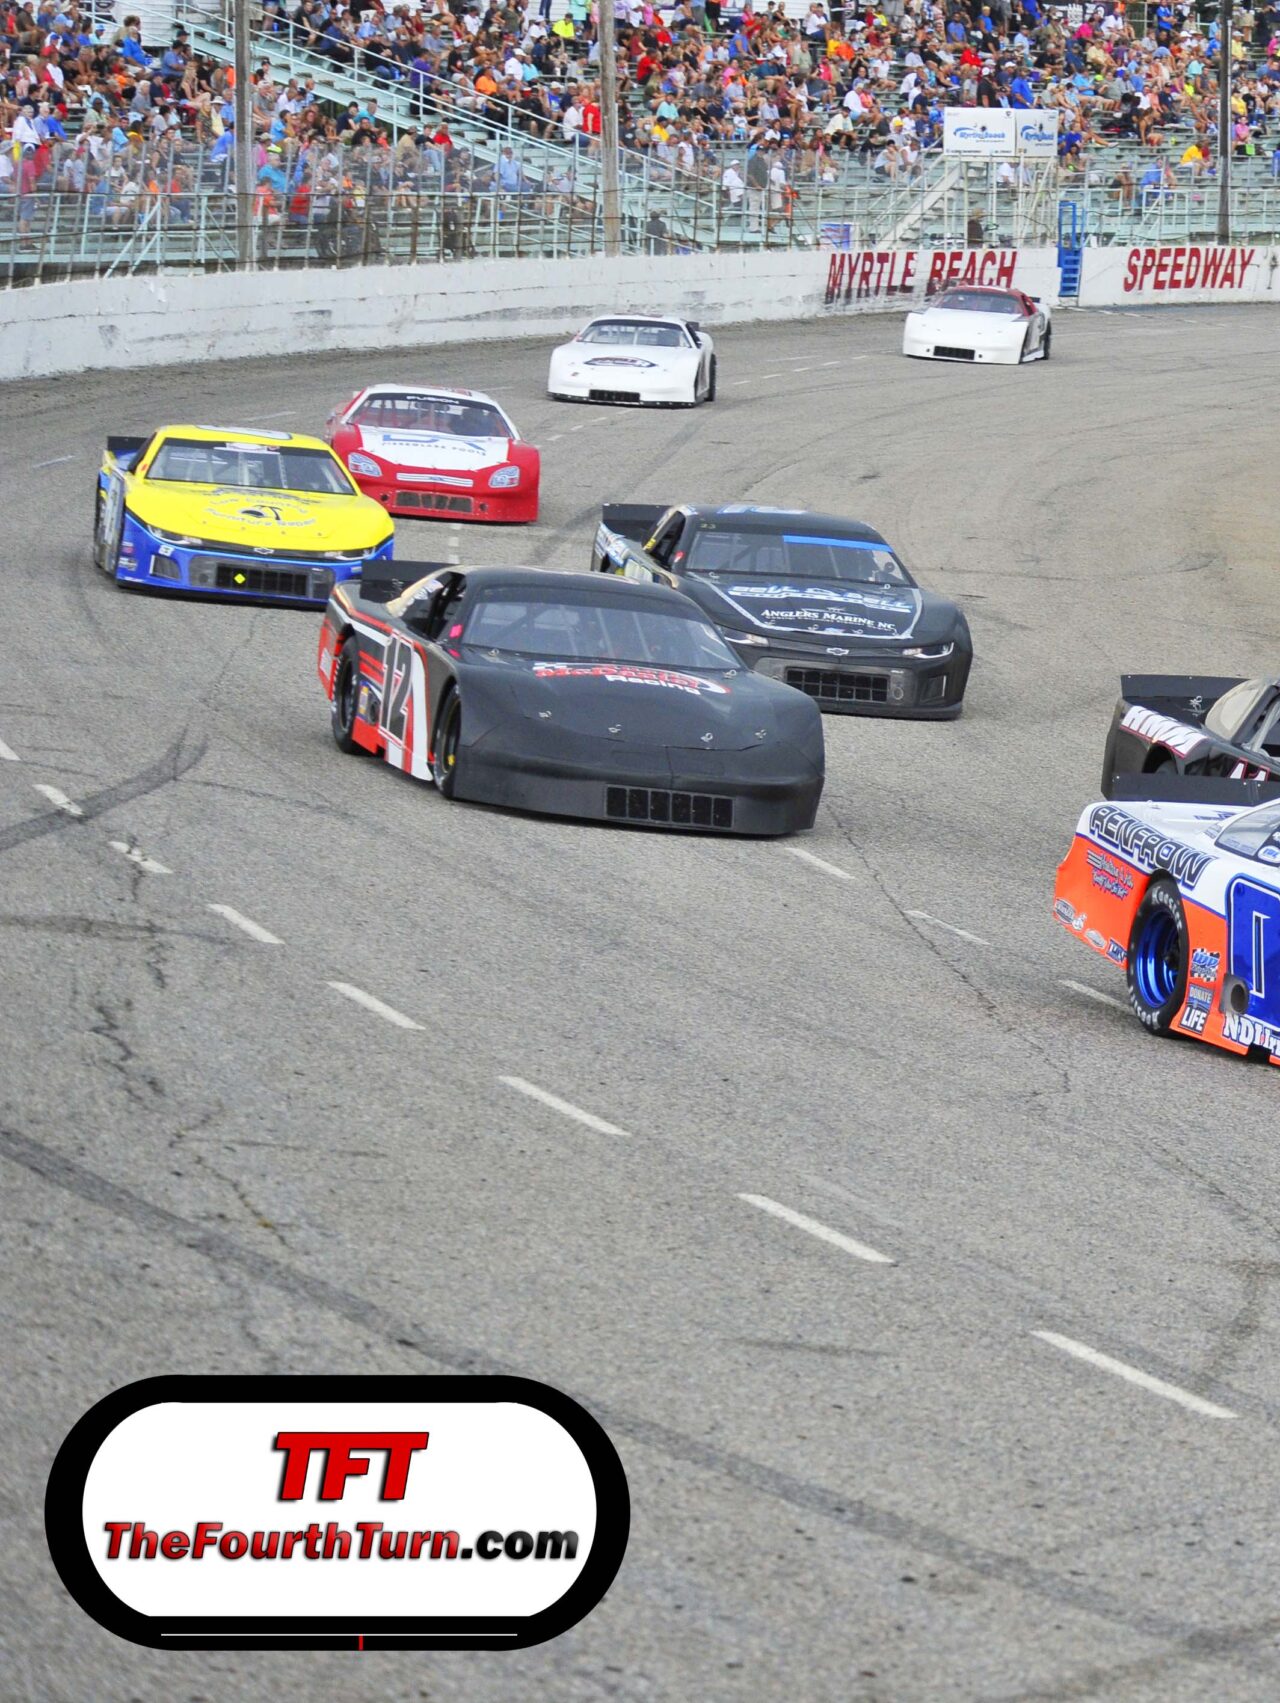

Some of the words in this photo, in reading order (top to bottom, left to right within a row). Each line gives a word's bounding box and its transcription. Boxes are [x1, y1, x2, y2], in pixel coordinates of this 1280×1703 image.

[824, 252, 914, 304] MYRTLE
[926, 251, 1017, 295] BEACH
[1123, 247, 1255, 292] SPEEDWAY
[823, 612, 877, 625] MARINE
[1089, 804, 1216, 891] RENFROW
[1189, 985, 1213, 1003] DONATE
[1180, 1006, 1206, 1030] LIFE
[1223, 1010, 1263, 1045] NDI
